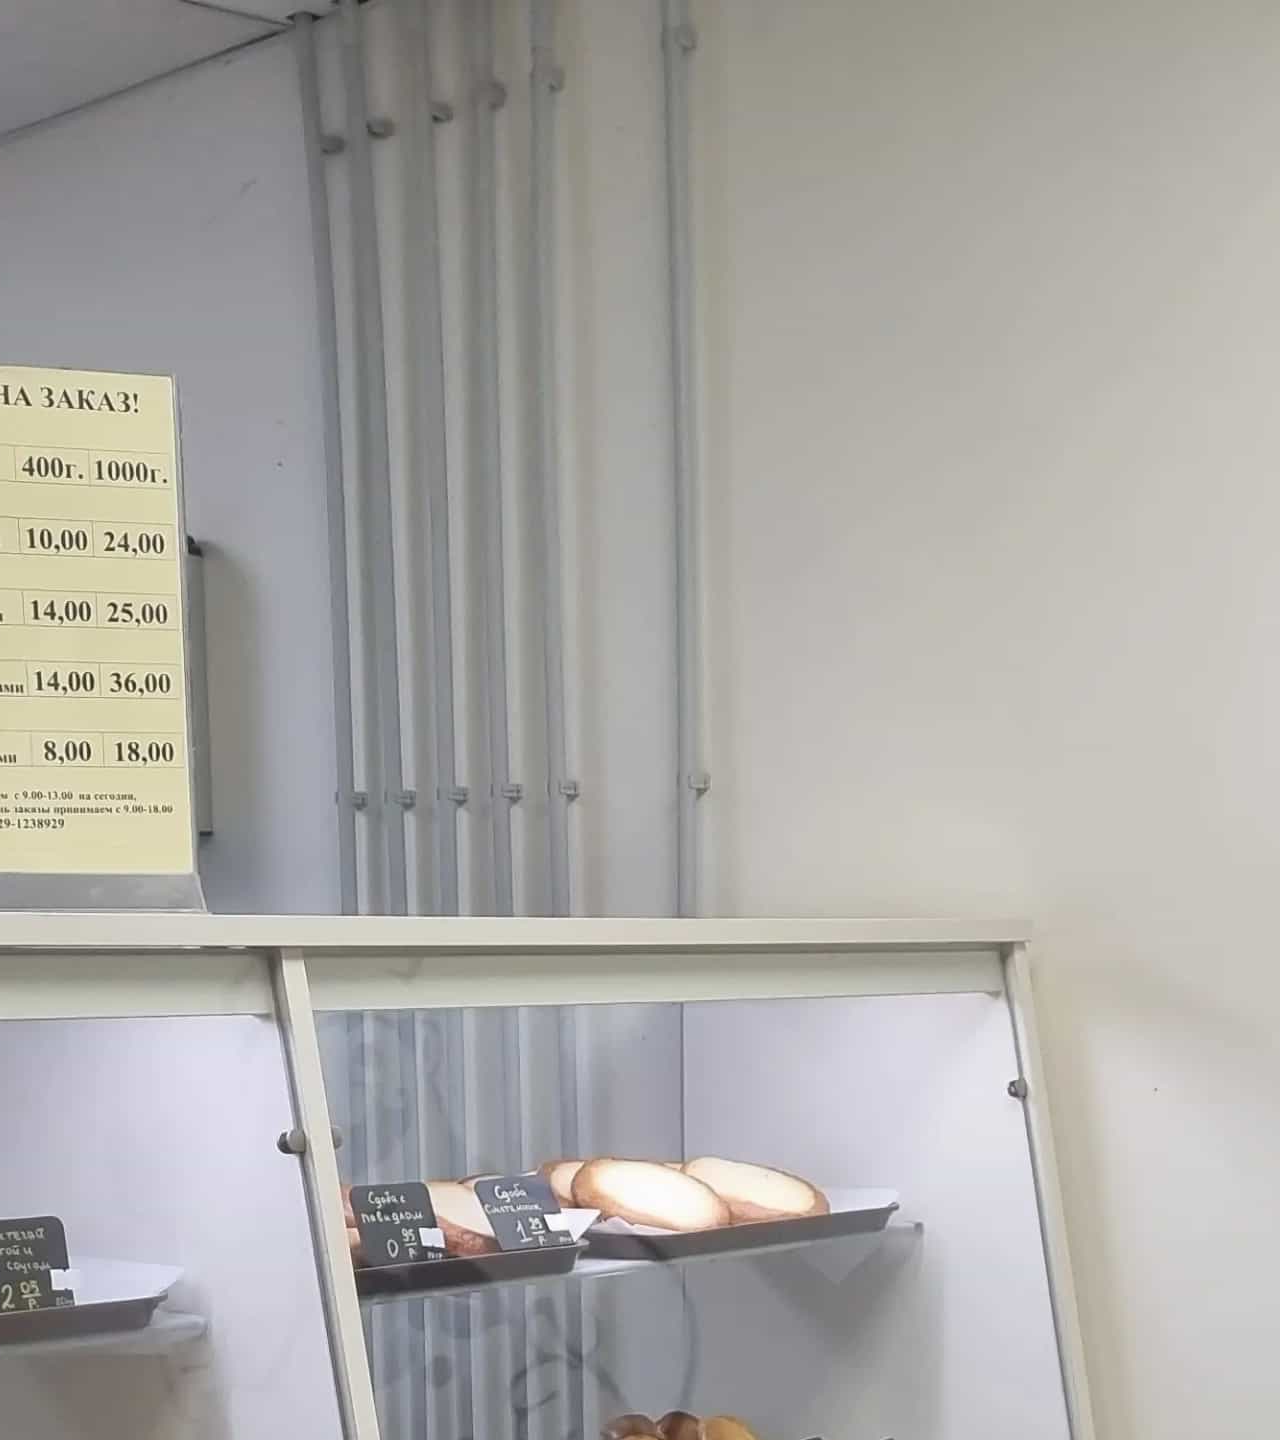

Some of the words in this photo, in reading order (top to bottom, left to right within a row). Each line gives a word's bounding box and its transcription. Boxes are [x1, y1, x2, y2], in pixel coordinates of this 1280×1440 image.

[40, 387, 139, 413] ЗАКАЗ!
[22, 456, 84, 480] 400г.
[95, 459, 169, 484] 1000г.
[26, 527, 88, 553] 10,00
[104, 531, 165, 556] 24,00
[30, 599, 92, 625] 14,00
[107, 602, 168, 625] 25,00
[34, 670, 95, 696] 14,00
[110, 672, 171, 697] 36,00
[43, 741, 92, 764] 8,00
[115, 742, 174, 765] 18,00
[22, 790, 73, 801] 9.00-13.00
[78, 793, 91, 801] на
[14, 805, 50, 813] заказы
[53, 805, 113, 815] принимаем
[123, 804, 173, 814] 9.00-18.00
[1, 1284, 15, 1310] 2
